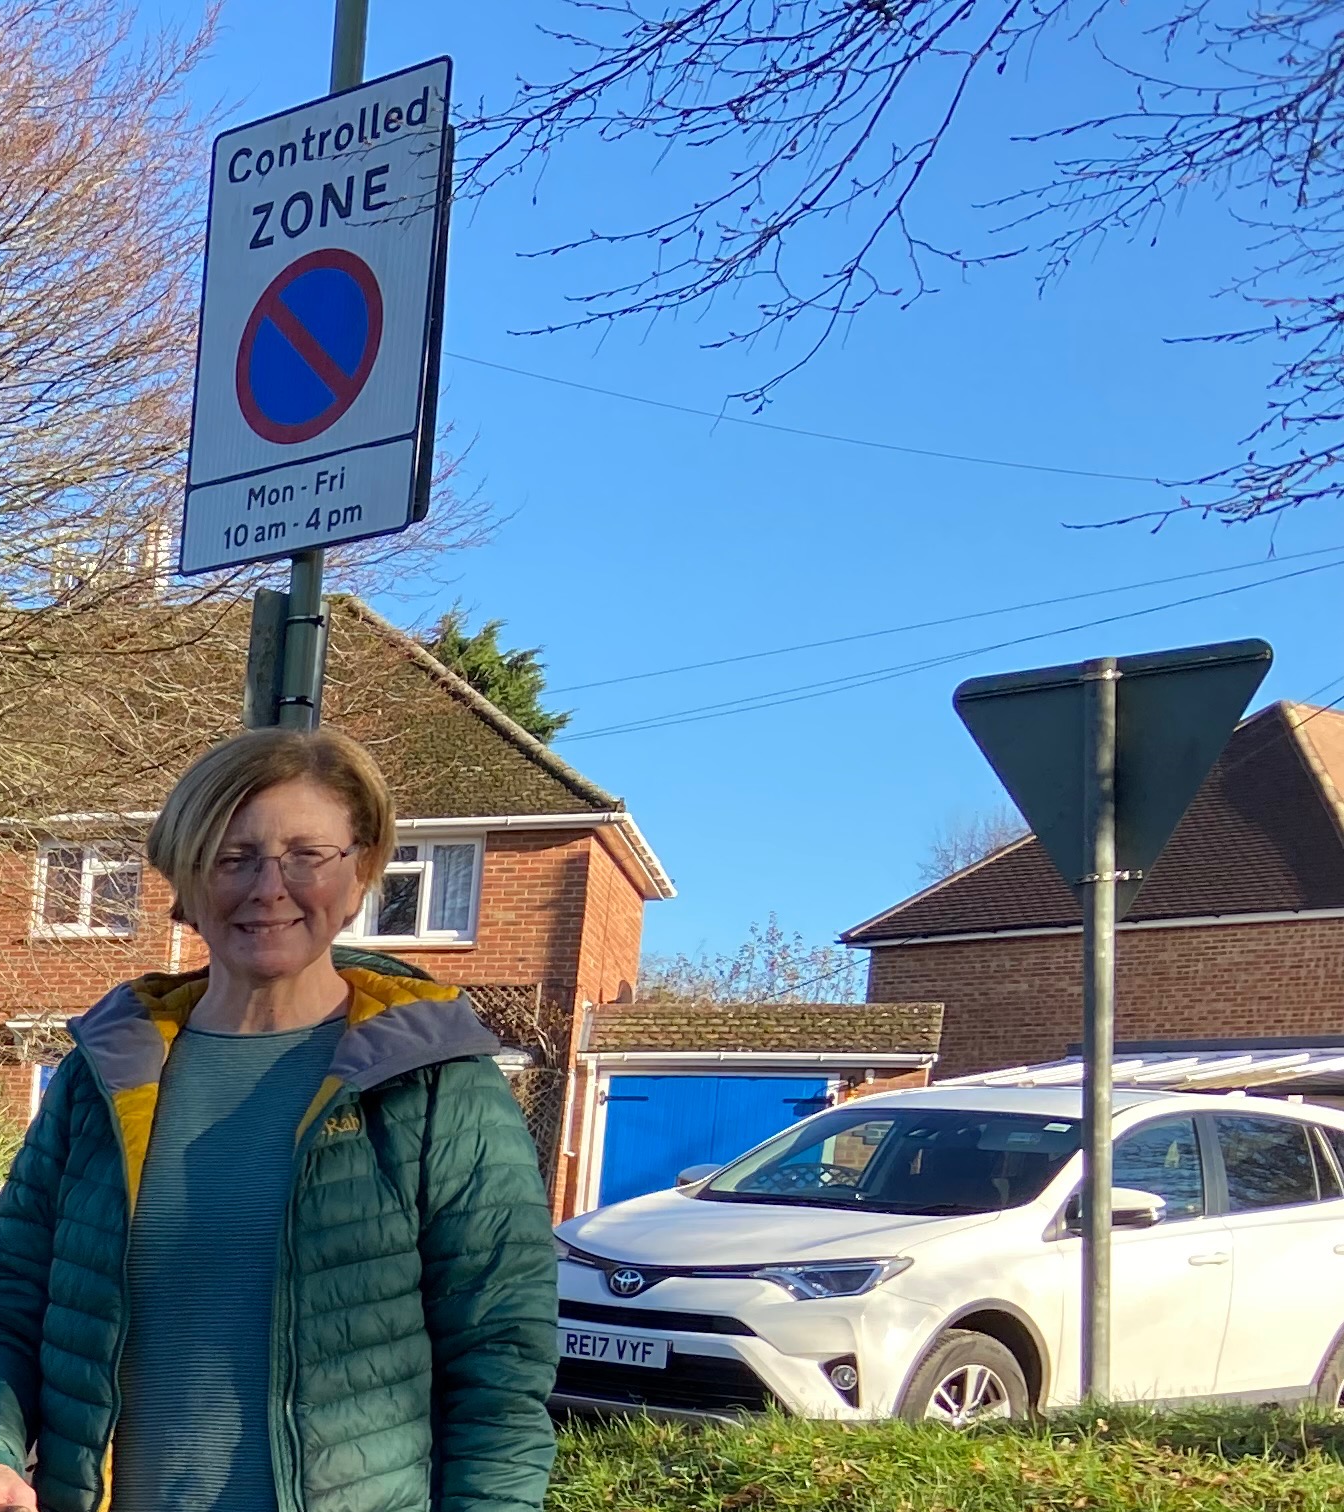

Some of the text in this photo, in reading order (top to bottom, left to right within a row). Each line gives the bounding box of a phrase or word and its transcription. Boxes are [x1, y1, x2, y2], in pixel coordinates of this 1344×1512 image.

[228, 86, 431, 184] Controlled
[249, 164, 390, 250] ZONE
[247, 484, 295, 510] Mon
[315, 466, 346, 496] Fri
[223, 522, 248, 550] 10
[252, 522, 286, 545] am
[305, 507, 321, 532] 4
[327, 504, 362, 533] pm
[324, 1113, 360, 1136] Rab
[566, 1333, 654, 1363] RE17 VYF
